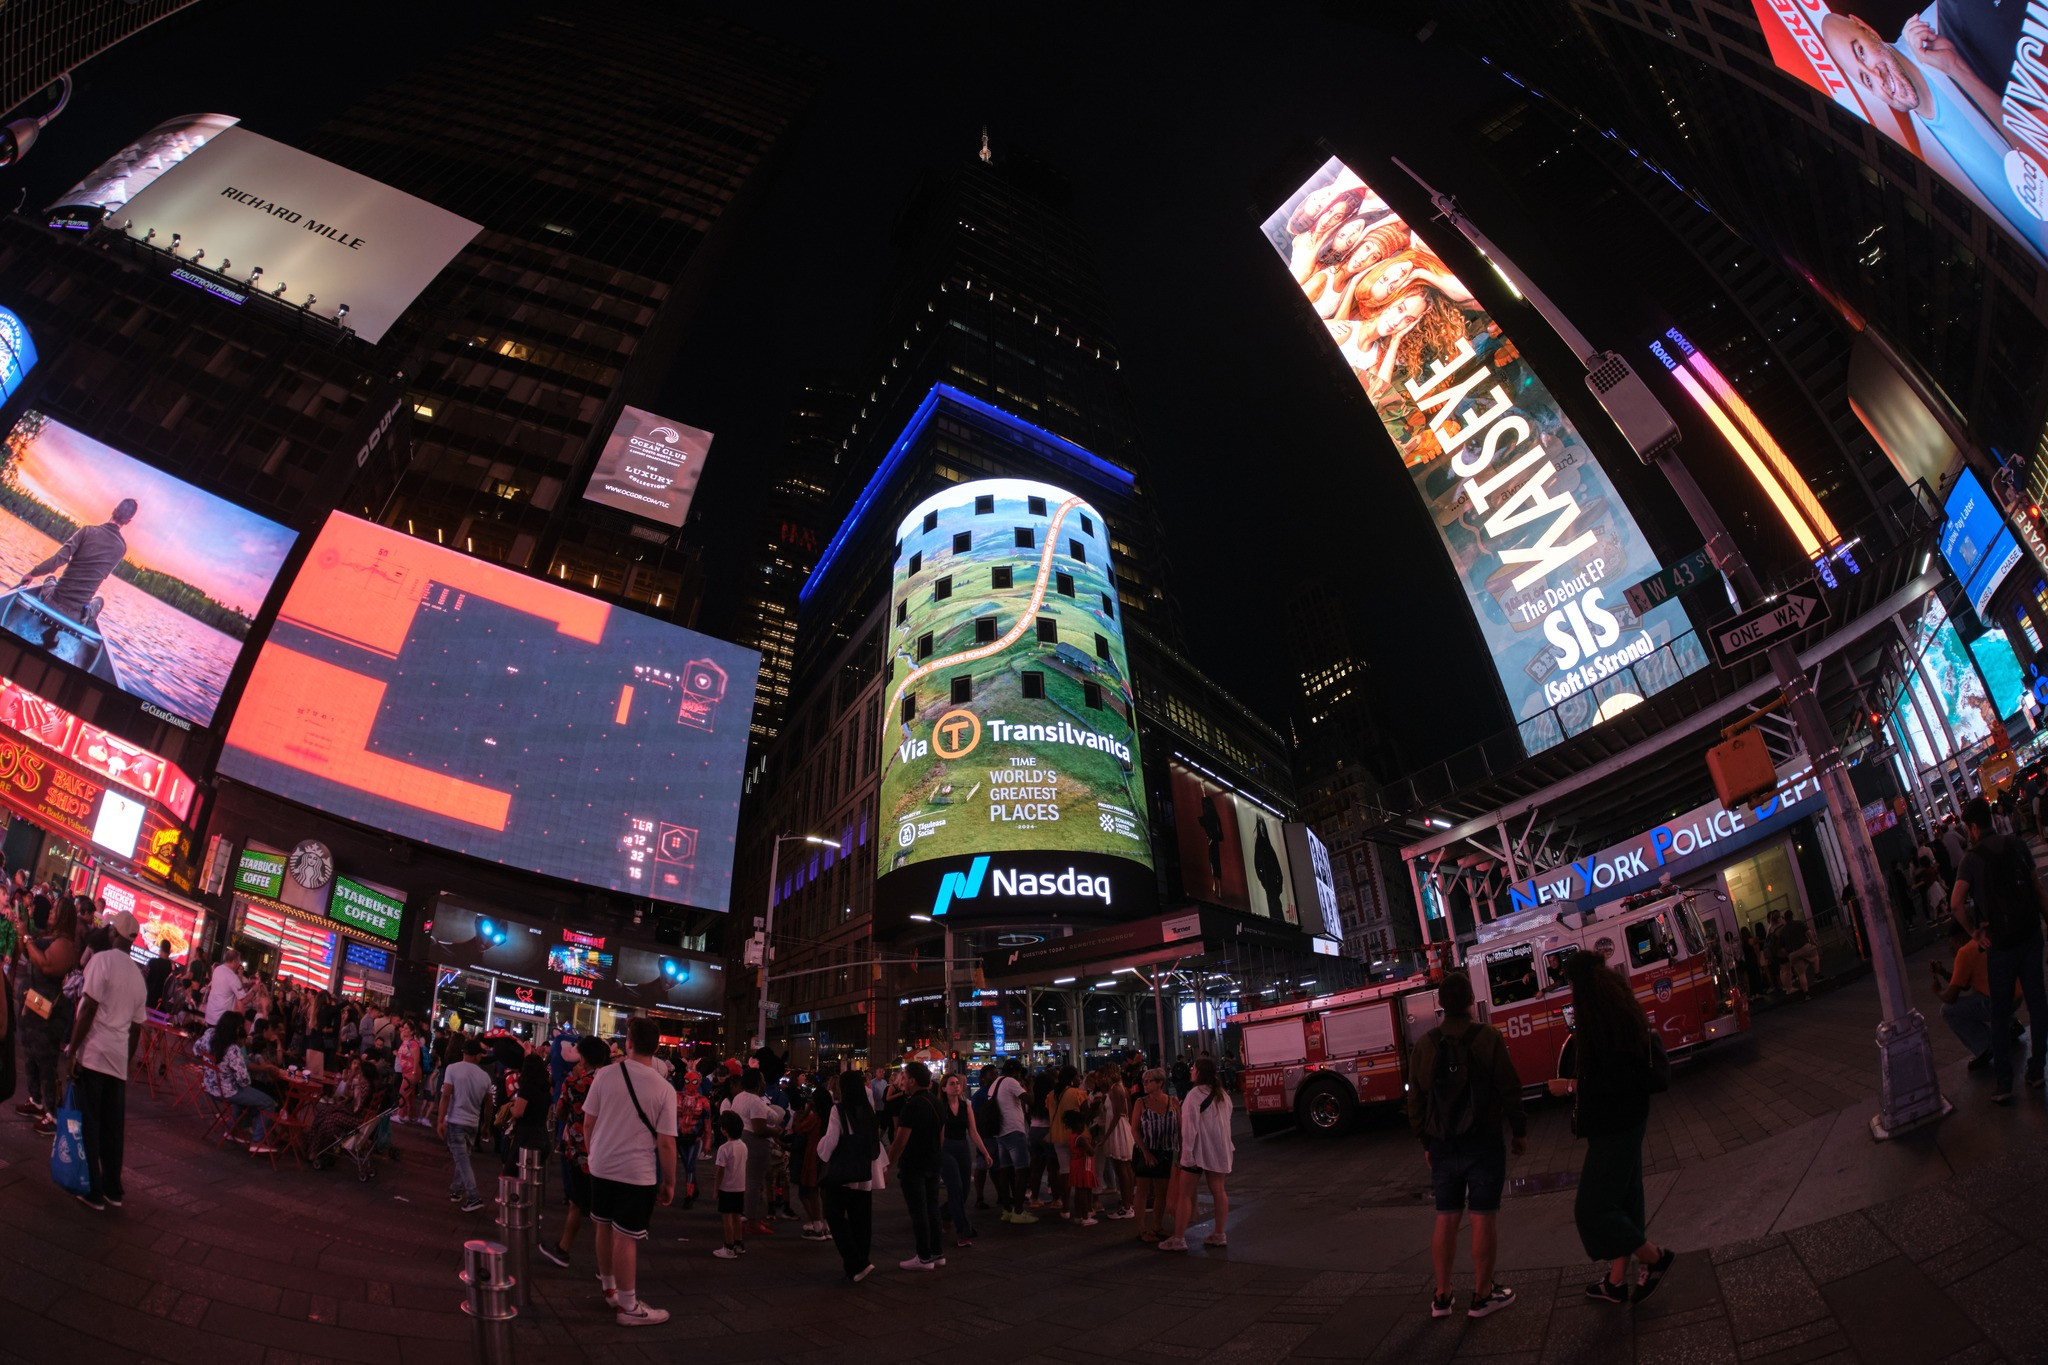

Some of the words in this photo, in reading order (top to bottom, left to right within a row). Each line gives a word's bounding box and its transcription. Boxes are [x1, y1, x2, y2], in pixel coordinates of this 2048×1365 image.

[2016, 160, 2043, 221] food
[221, 186, 303, 224] RICHARD
[303, 219, 366, 250] MILLE
[173, 268, 247, 302] #OUTFRONTPRIME
[630, 438, 661, 453] OCEAN
[662, 448, 687, 461] CLUB
[625, 465, 674, 486] LUXURY
[1404, 337, 1598, 593] KATSEYE
[1963, 498, 1976, 521] Later
[2001, 550, 2020, 575] CHASE
[1647, 577, 1668, 601] W
[1673, 563, 1696, 588] 43
[1696, 553, 1711, 568] St
[1517, 601, 1549, 623] The
[1544, 571, 1592, 604] Debut
[1585, 557, 1606, 580] EP
[1543, 587, 1620, 671] SIS
[1729, 621, 1764, 649] ONE
[1773, 599, 1808, 628] WAY
[931, 654, 965, 670] DISCOVER
[1004, 627, 1021, 644] FIRST
[1019, 612, 1033, 629] LONG
[1544, 671, 1585, 707] (Soft
[1579, 663, 1598, 687] Is
[1593, 629, 1655, 674] Strong)
[899, 739, 928, 764] Via
[986, 719, 1131, 763] Transilvanica
[1009, 757, 1036, 767] TIME
[52, 769, 98, 803] BAKE
[989, 769, 1057, 784] WORLD'S
[44, 785, 92, 820] SHOP
[989, 787, 1058, 801] GREATEST
[46, 806, 68, 824] Buddy
[990, 803, 1060, 822] PLACES
[632, 818, 654, 833] TER
[917, 828, 935, 838] Social
[633, 834, 647, 846] 12
[239, 856, 283, 875] STARBUCKS
[630, 849, 645, 862] 32
[1509, 876, 1573, 912] NEW
[1572, 847, 1650, 897] YORK
[1650, 807, 1746, 867] POLICE
[242, 872, 272, 889] COFFEE
[629, 866, 642, 879] 15
[102, 886, 136, 908] CHICKEN
[992, 867, 1112, 905] Nasdaq
[335, 884, 402, 920] STARBUCKS
[344, 904, 387, 930] COFFEE
[1022, 950, 1048, 959] QUESTION
[1049, 946, 1066, 955] TODAY
[1069, 940, 1097, 951] REWRITE
[562, 974, 594, 990] NETFLIX
[564, 986, 582, 995] JUNE
[980, 989, 999, 997] Nasdaq
[1507, 1013, 1533, 1039] 65
[1254, 1072, 1280, 1088] FDNY
